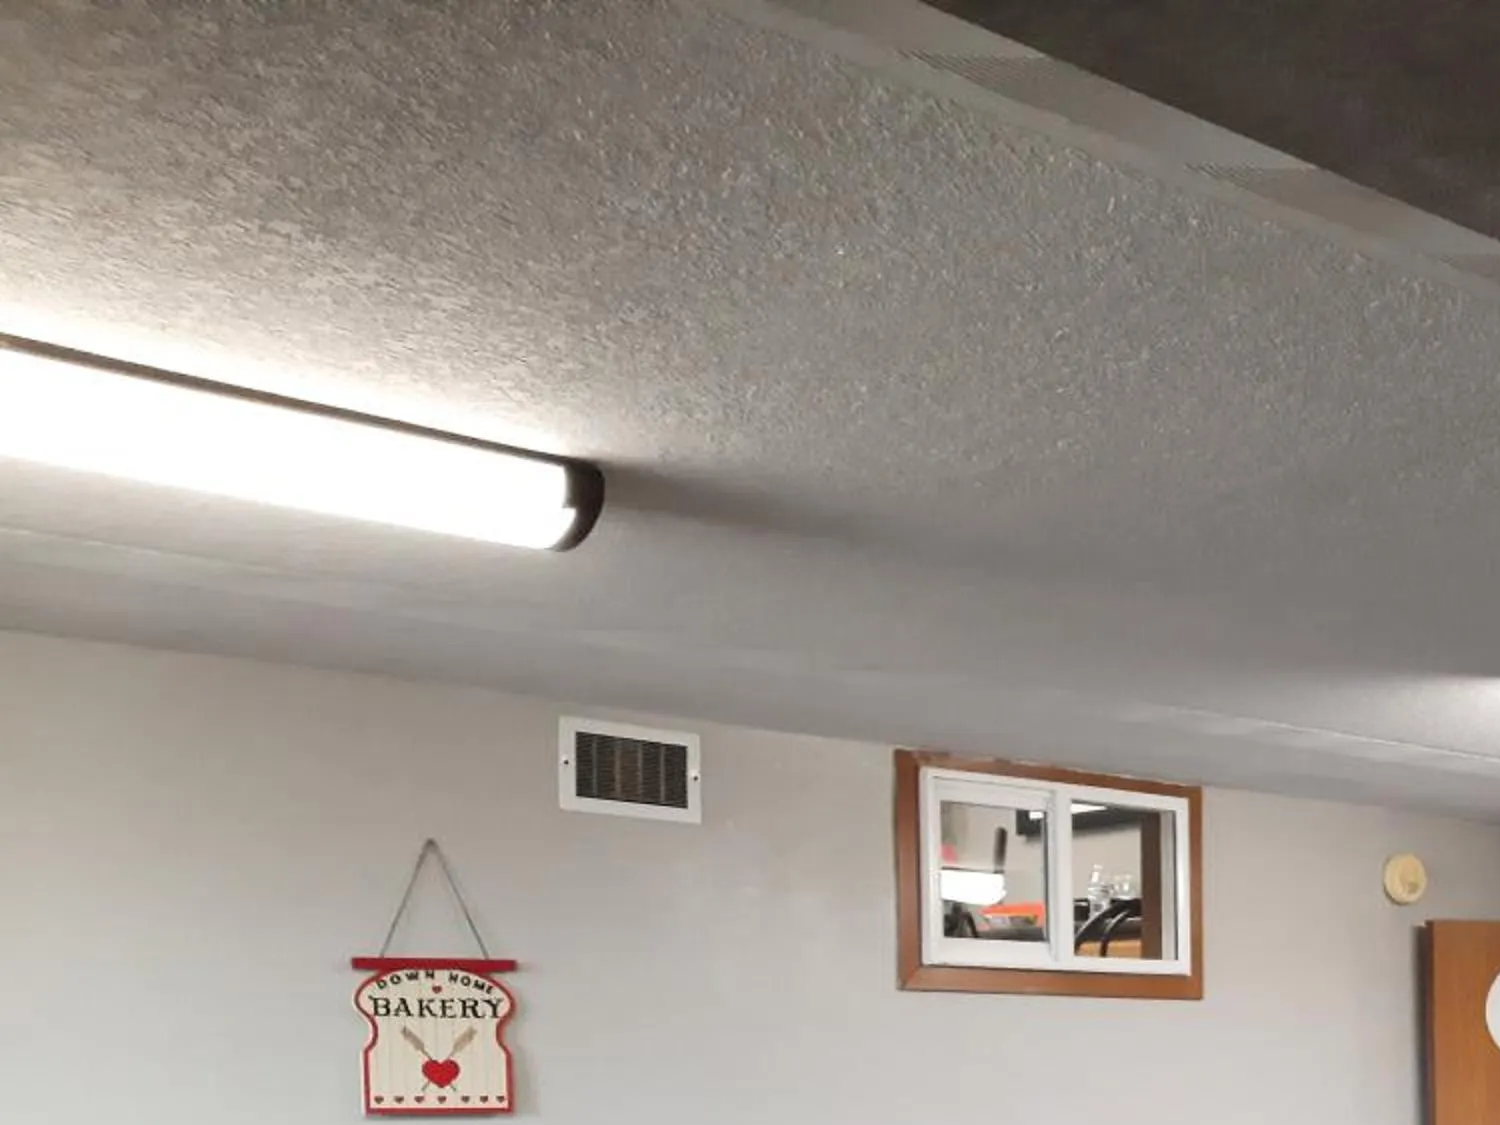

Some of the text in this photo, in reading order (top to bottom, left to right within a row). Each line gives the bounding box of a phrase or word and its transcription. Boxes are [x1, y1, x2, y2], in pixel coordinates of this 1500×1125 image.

[376, 971, 493, 994] DOWN HOME
[368, 995, 504, 1019] BAKERY
